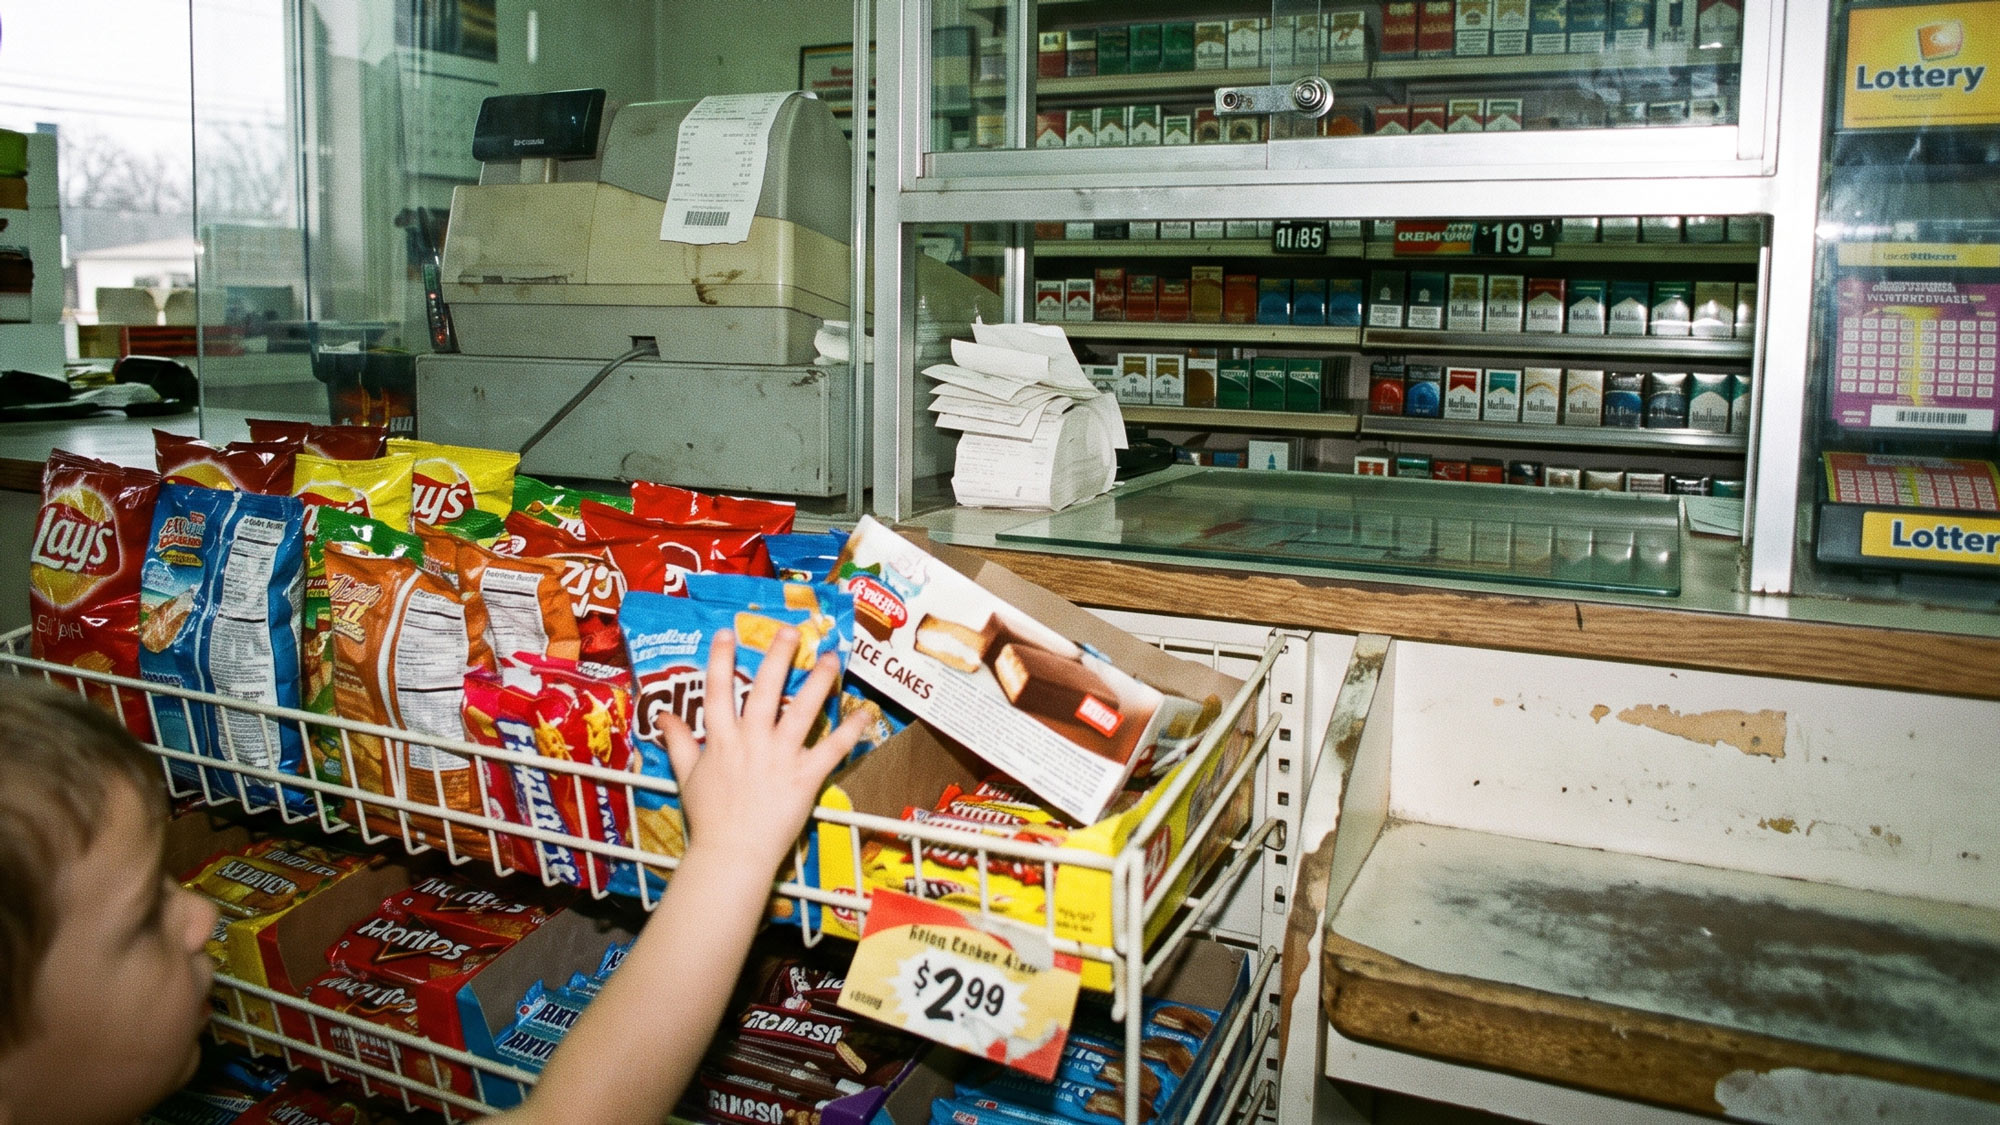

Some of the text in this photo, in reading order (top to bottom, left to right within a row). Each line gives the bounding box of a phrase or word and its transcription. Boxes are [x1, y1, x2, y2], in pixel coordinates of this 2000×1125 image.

[1856, 64, 1986, 93] Lottery
[412, 483, 467, 525] ay's
[31, 507, 114, 573] Lay's
[1892, 521, 2000, 553] Lotter
[853, 636, 934, 700] ICE CAKES
